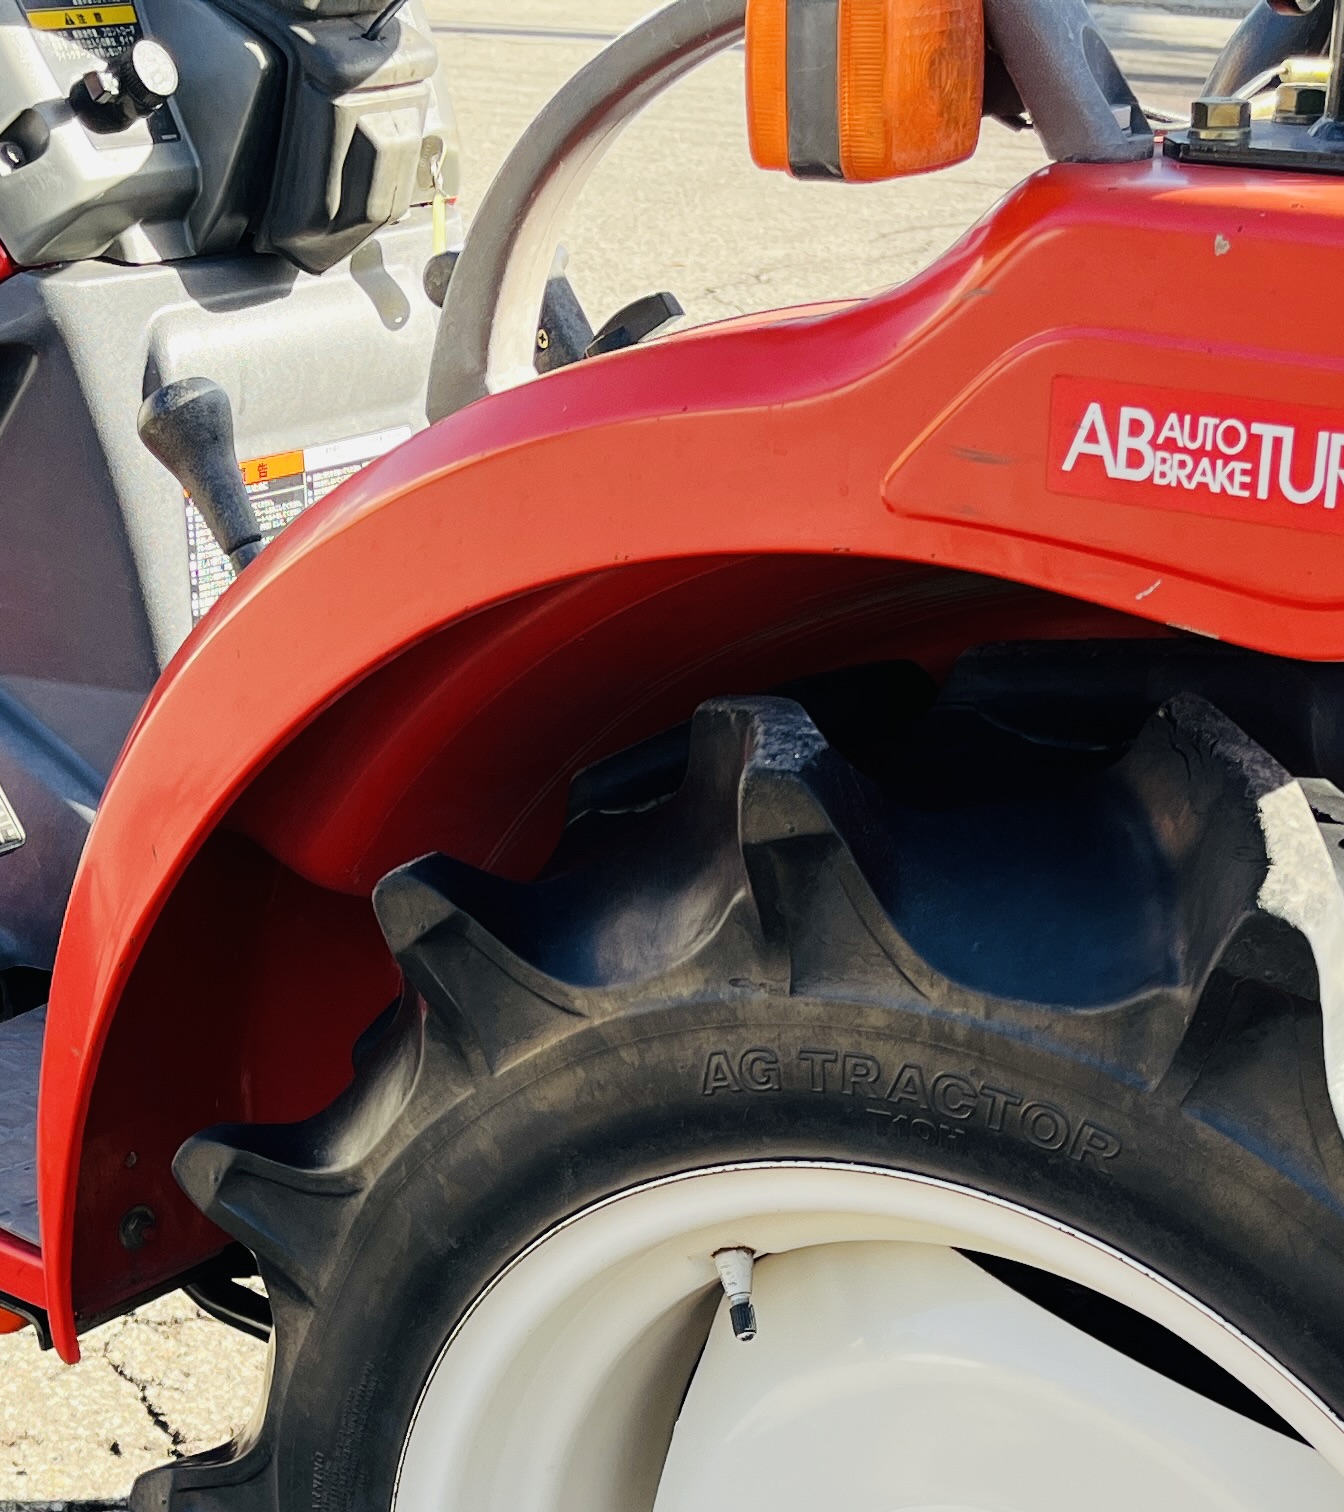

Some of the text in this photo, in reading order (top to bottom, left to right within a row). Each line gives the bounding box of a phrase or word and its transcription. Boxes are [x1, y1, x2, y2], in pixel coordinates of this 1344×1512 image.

[1061, 402, 1155, 482] AB
[1156, 412, 1248, 455] AUTO
[1154, 453, 1253, 498] BRAKE
[702, 1047, 1123, 1175] AG TRACTOR
